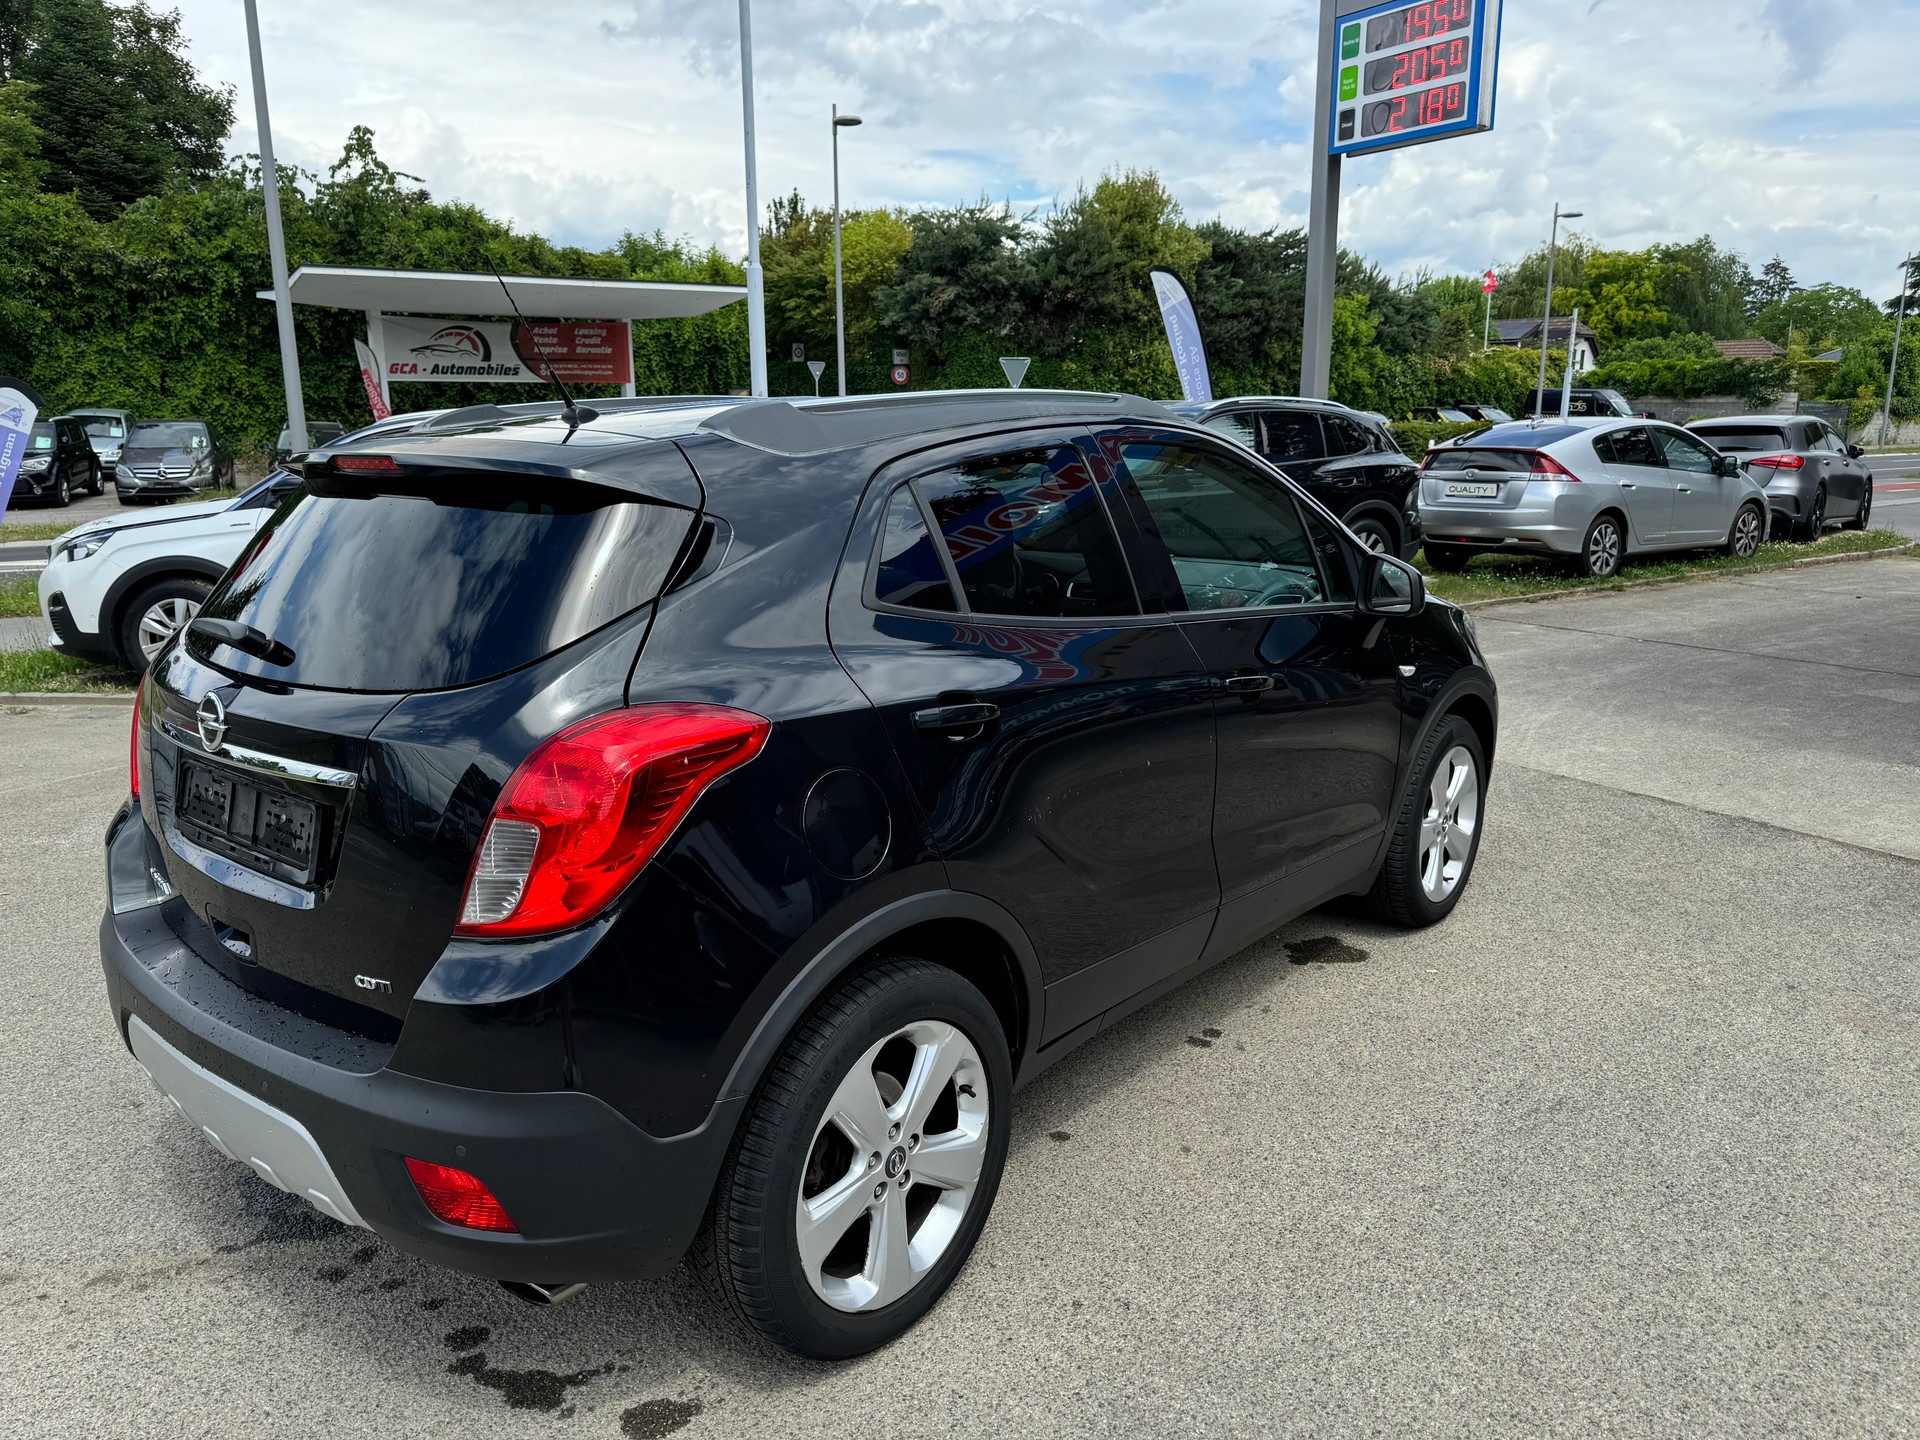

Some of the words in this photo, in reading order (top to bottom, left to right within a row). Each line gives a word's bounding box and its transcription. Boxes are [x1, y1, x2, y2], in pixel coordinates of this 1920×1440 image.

[532, 326, 559, 335] Achat
[574, 327, 608, 337] Leasing
[575, 346, 613, 355] Garantie
[389, 363, 418, 375] GCA
[430, 363, 520, 376] Automobiles
[896, 371, 905, 379] 50
[1448, 485, 1488, 495] QUALITY
[819, 1070, 832, 1086] 18
